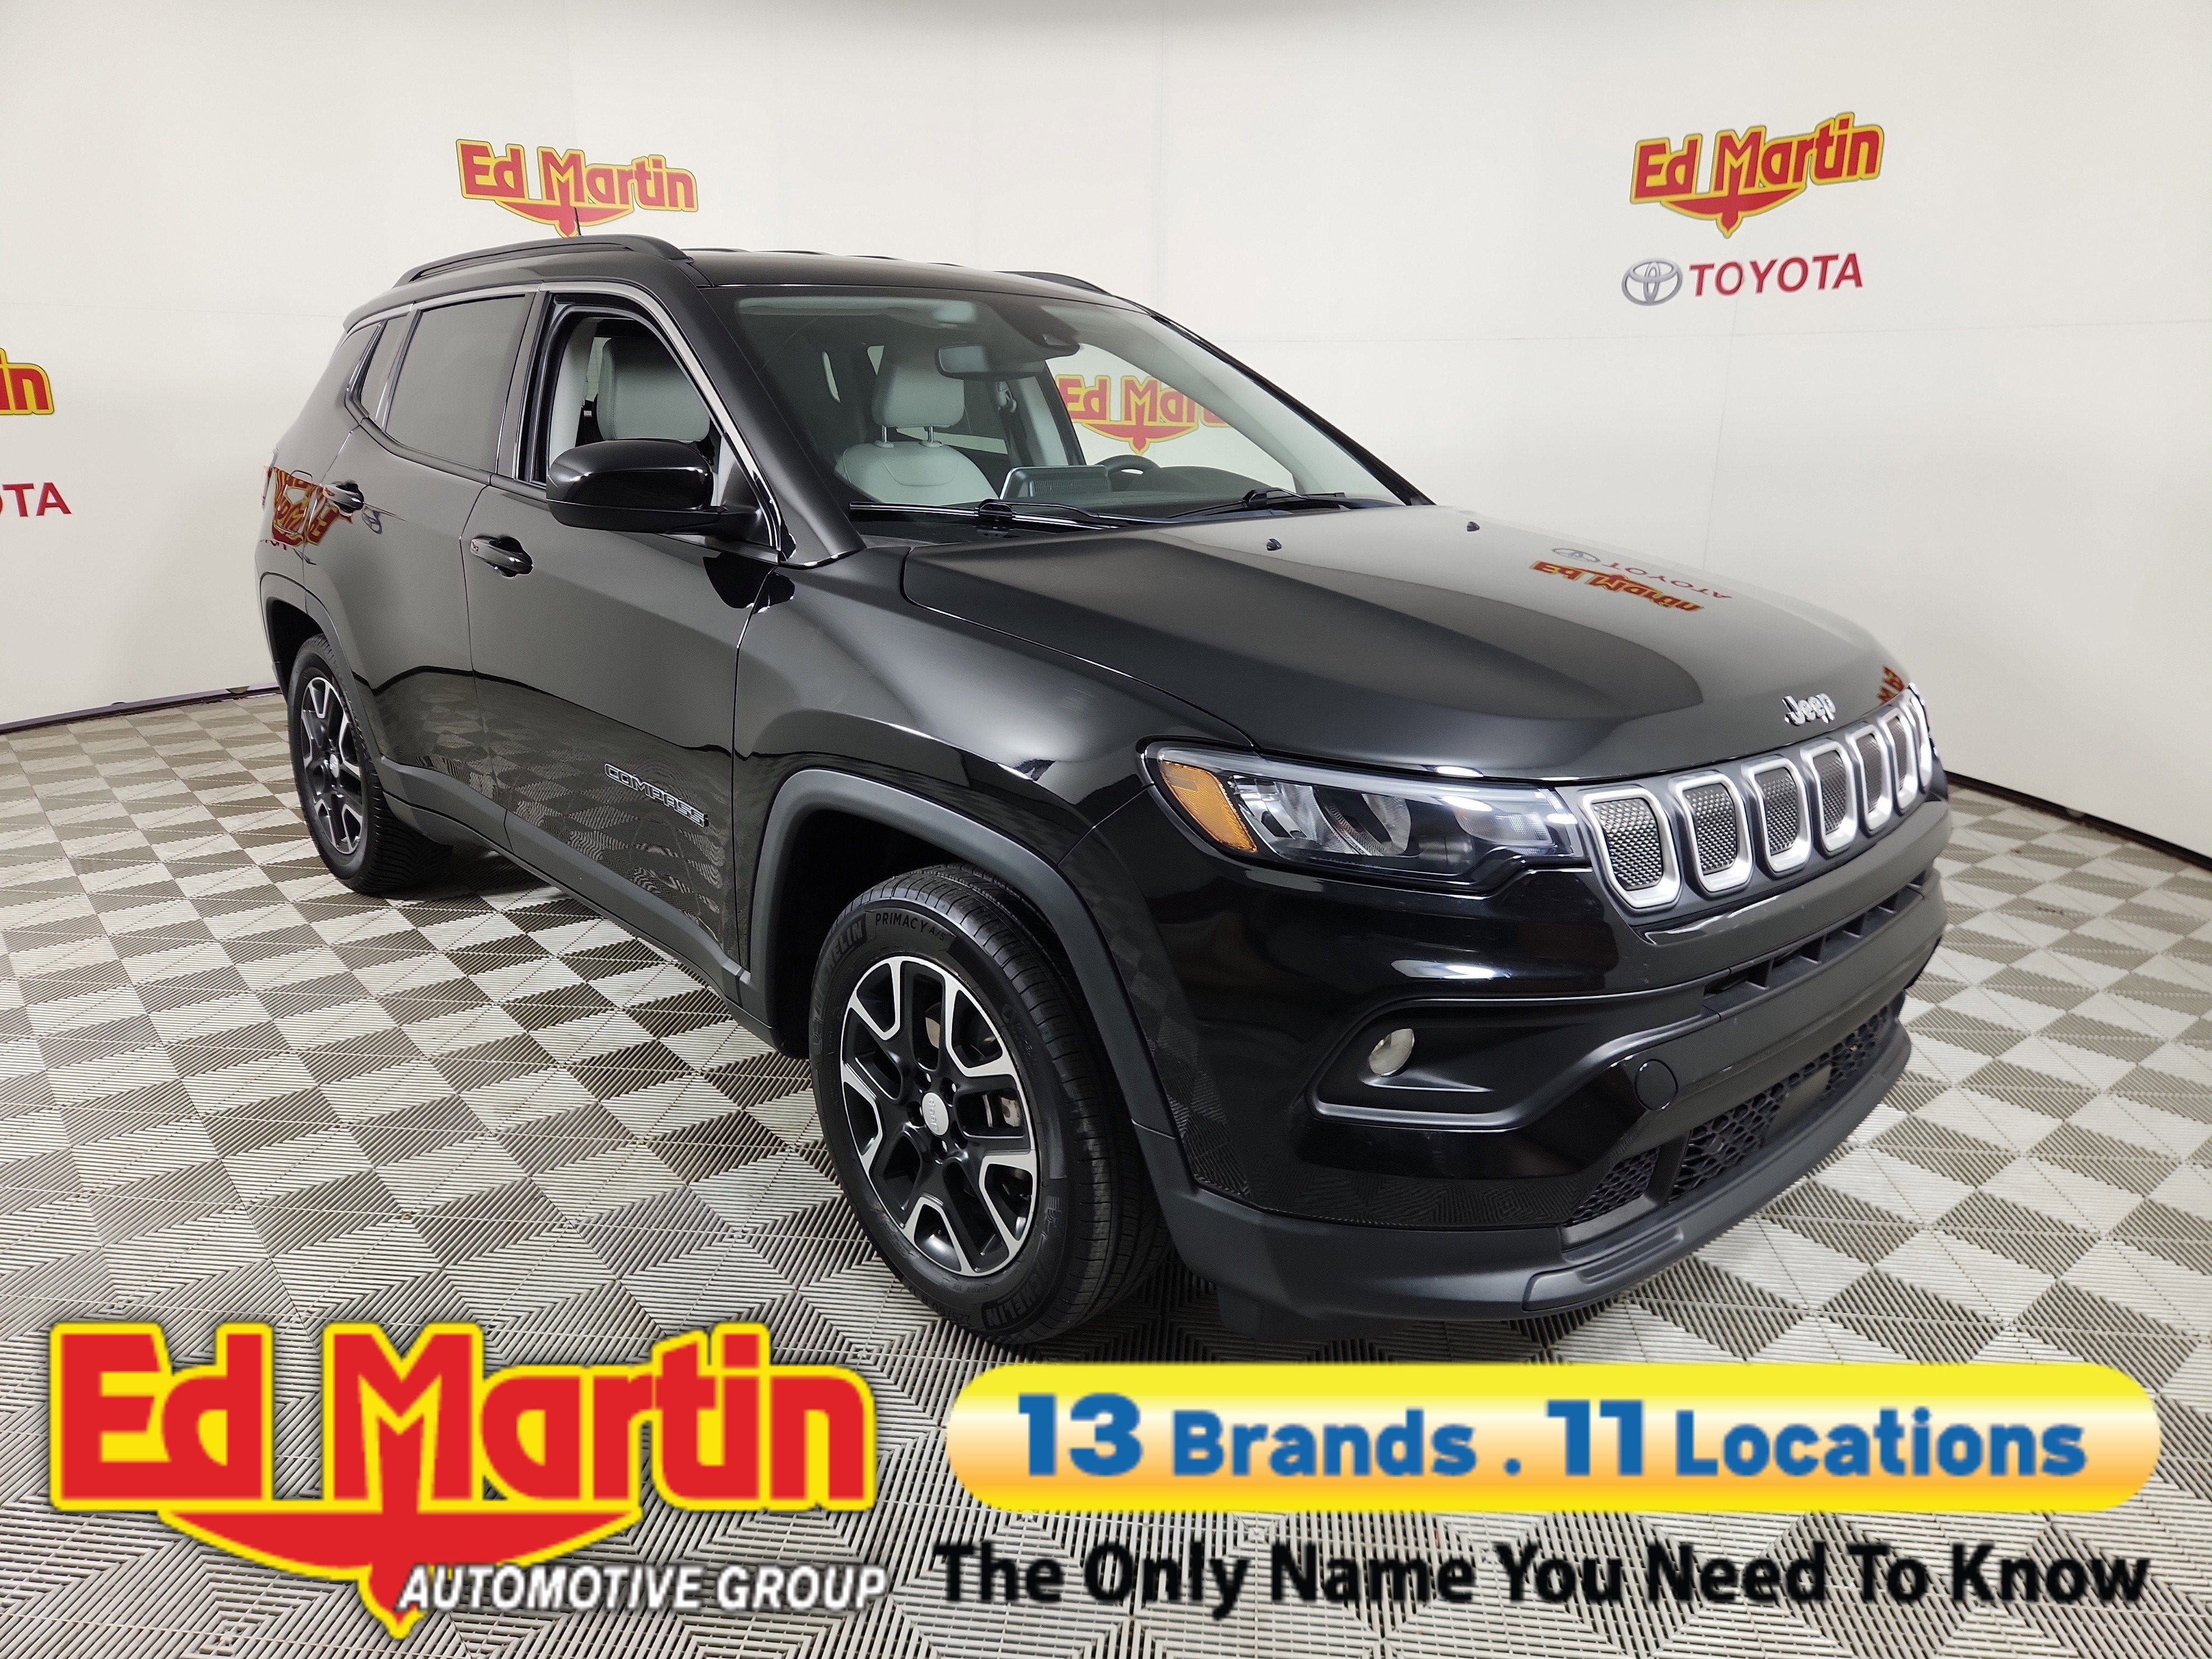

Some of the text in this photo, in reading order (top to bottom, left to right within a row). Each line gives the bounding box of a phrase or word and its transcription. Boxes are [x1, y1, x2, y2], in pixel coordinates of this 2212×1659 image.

[458, 142, 697, 210] Ed Martin
[1632, 114, 1881, 201] Ed Martin
[1689, 253, 1863, 297] TOYOTA
[1057, 375, 1110, 422] Ed
[0, 482, 72, 517] TA
[1782, 693, 1836, 726] Jeep
[605, 763, 708, 828] COMPASS
[876, 912, 946, 941] PRIMACY A/S
